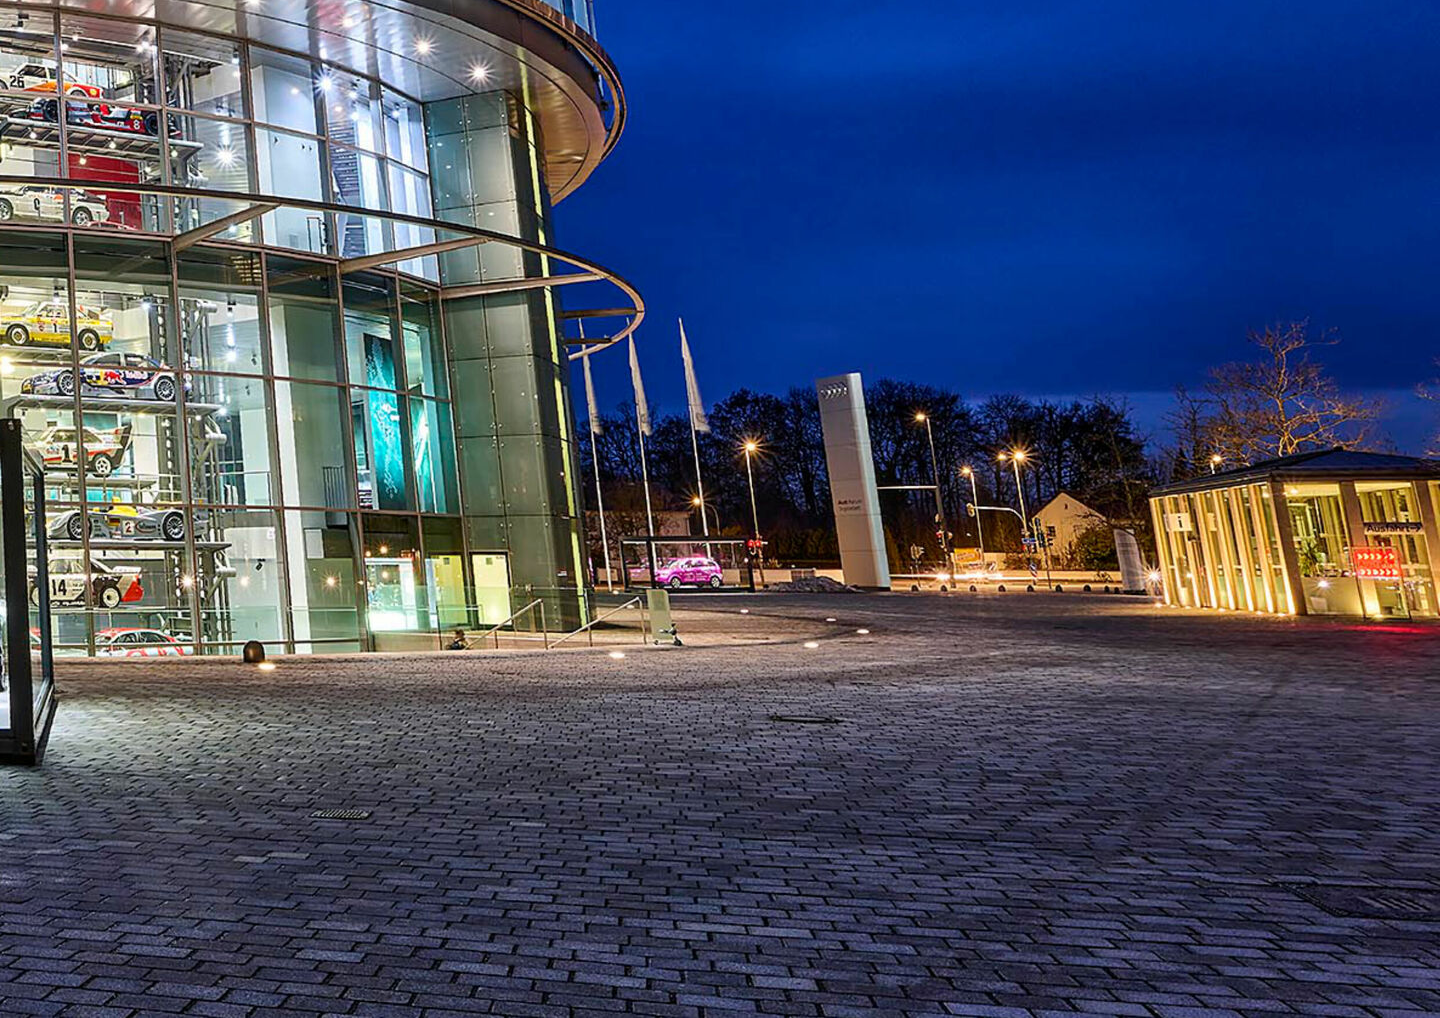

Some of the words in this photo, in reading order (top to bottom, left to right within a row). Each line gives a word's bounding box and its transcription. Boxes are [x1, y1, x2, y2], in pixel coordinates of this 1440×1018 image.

[10, 75, 25, 88] 26
[133, 119, 141, 131] 8
[62, 444, 73, 462] 1
[125, 522, 132, 533] 2
[1367, 523, 1409, 532] Ausfahrt
[52, 579, 67, 595] 14
